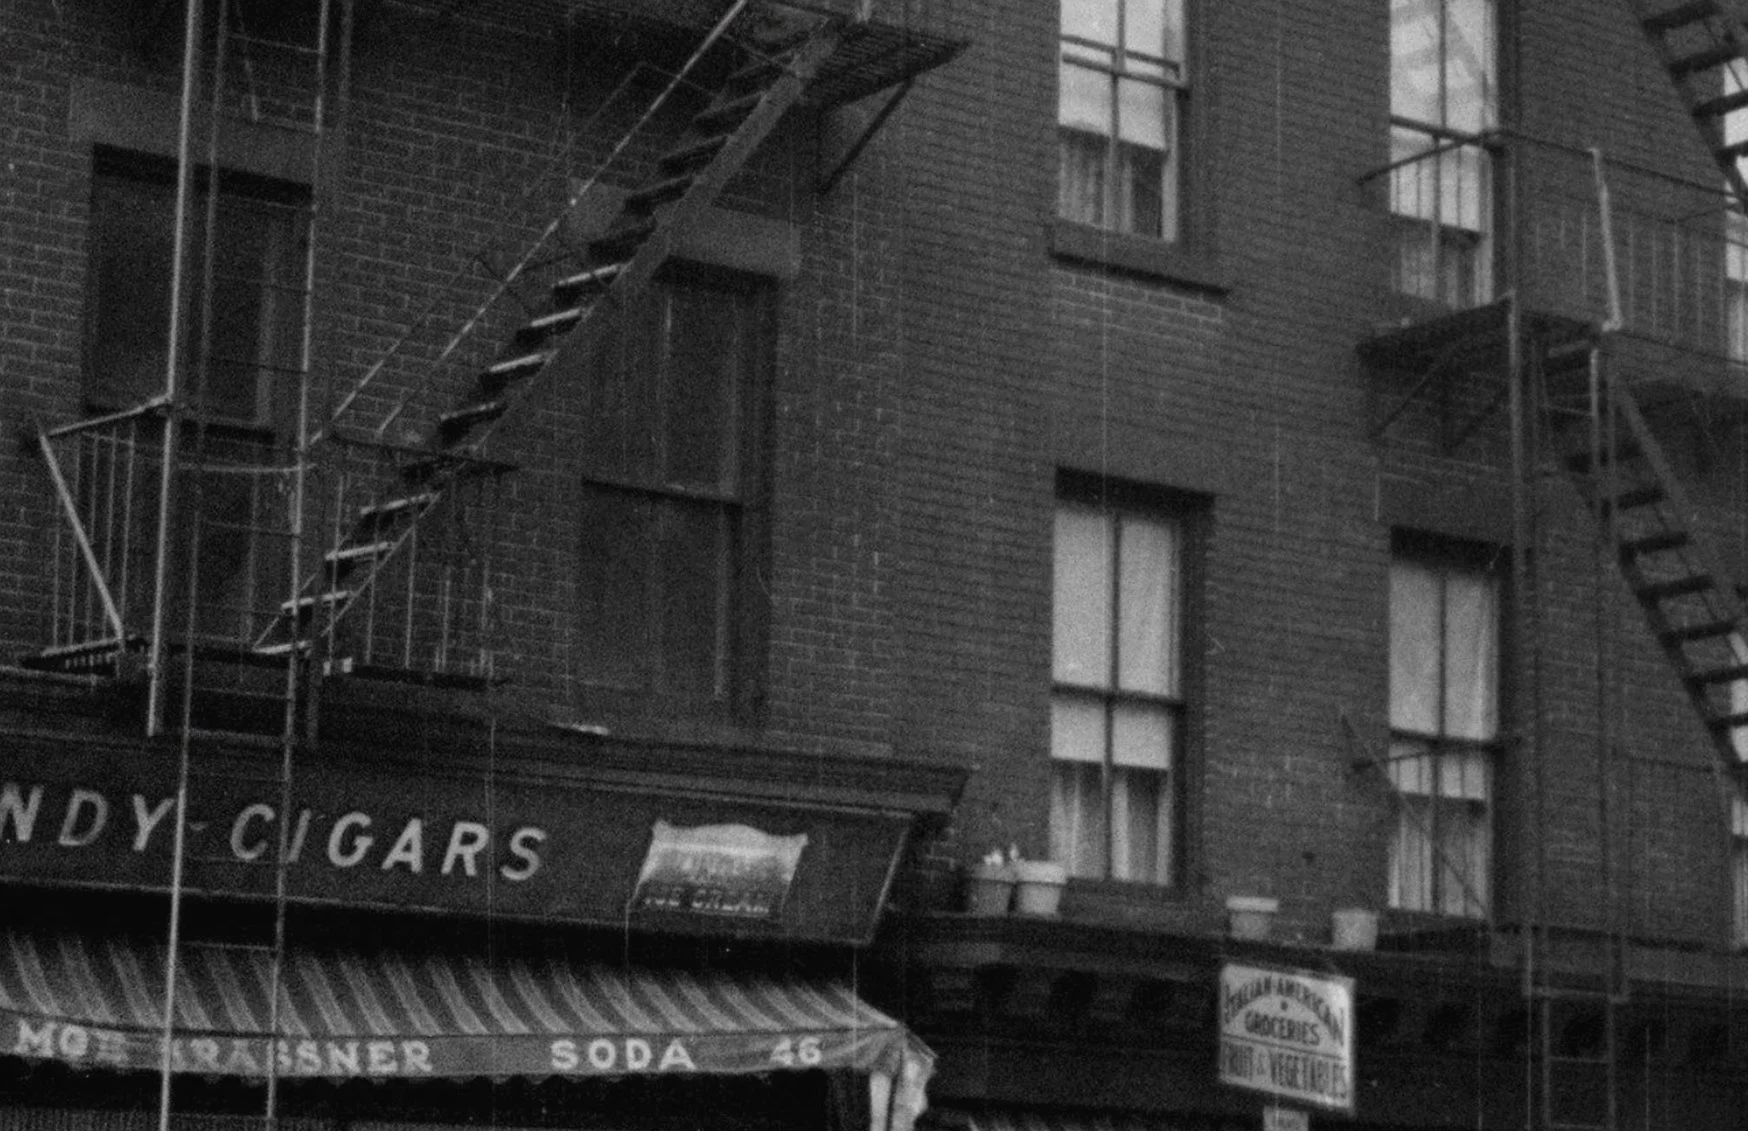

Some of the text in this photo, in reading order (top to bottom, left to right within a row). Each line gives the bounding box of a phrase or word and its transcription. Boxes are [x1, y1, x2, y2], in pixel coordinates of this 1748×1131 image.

[229, 803, 548, 881] CIGARS
[1245, 1010, 1320, 1046] GROCERIES
[551, 1039, 697, 1072] SODA
[769, 1036, 823, 1066] 46
